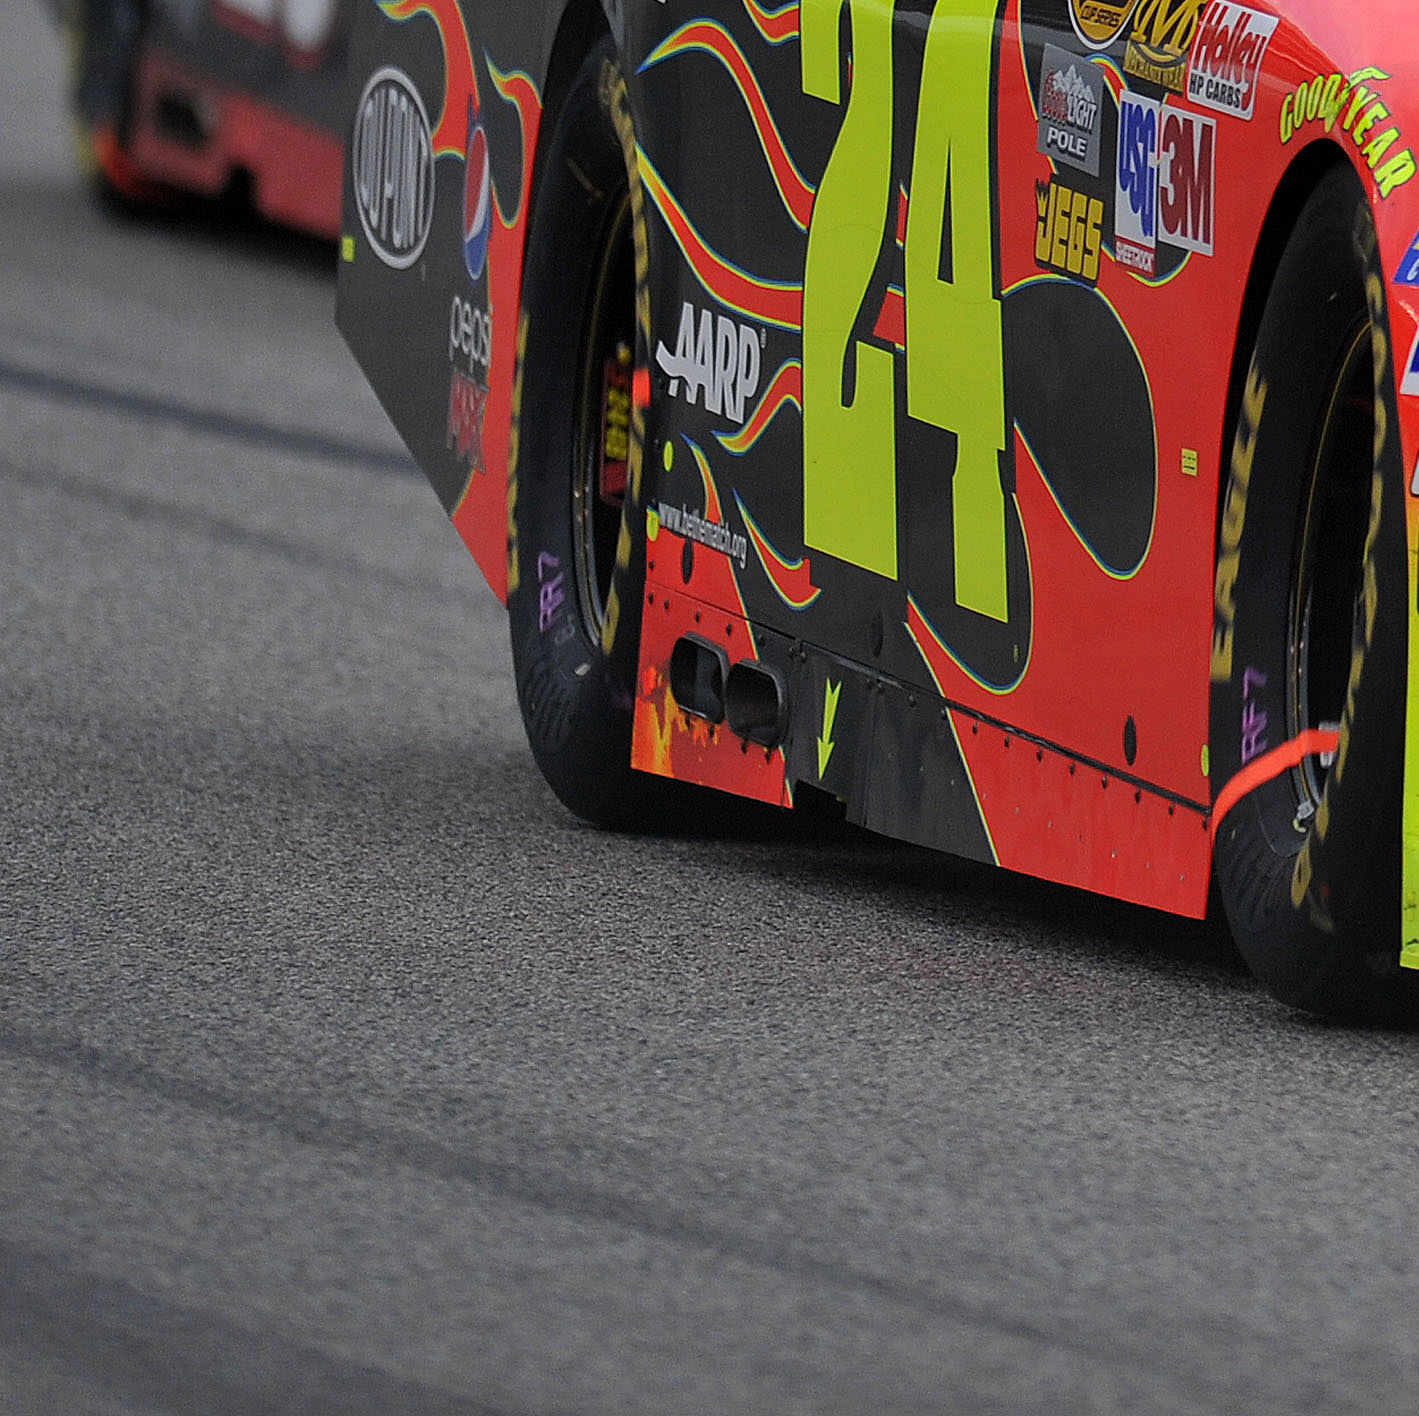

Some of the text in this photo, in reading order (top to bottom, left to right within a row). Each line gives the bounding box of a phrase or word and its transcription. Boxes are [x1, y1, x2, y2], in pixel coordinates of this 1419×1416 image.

[1066, 88, 1097, 132] LIGHT
[1189, 73, 1241, 109] HP CARBS
[1194, 2, 1268, 111] Holley
[359, 86, 428, 249] DUPONT
[1046, 126, 1088, 159] POLE
[1118, 100, 1156, 238] USG
[1160, 113, 1214, 246] 3M
[1035, 181, 1105, 282] JEGS
[655, 301, 761, 425] AARP
[1210, 352, 1270, 681] EAGLE
